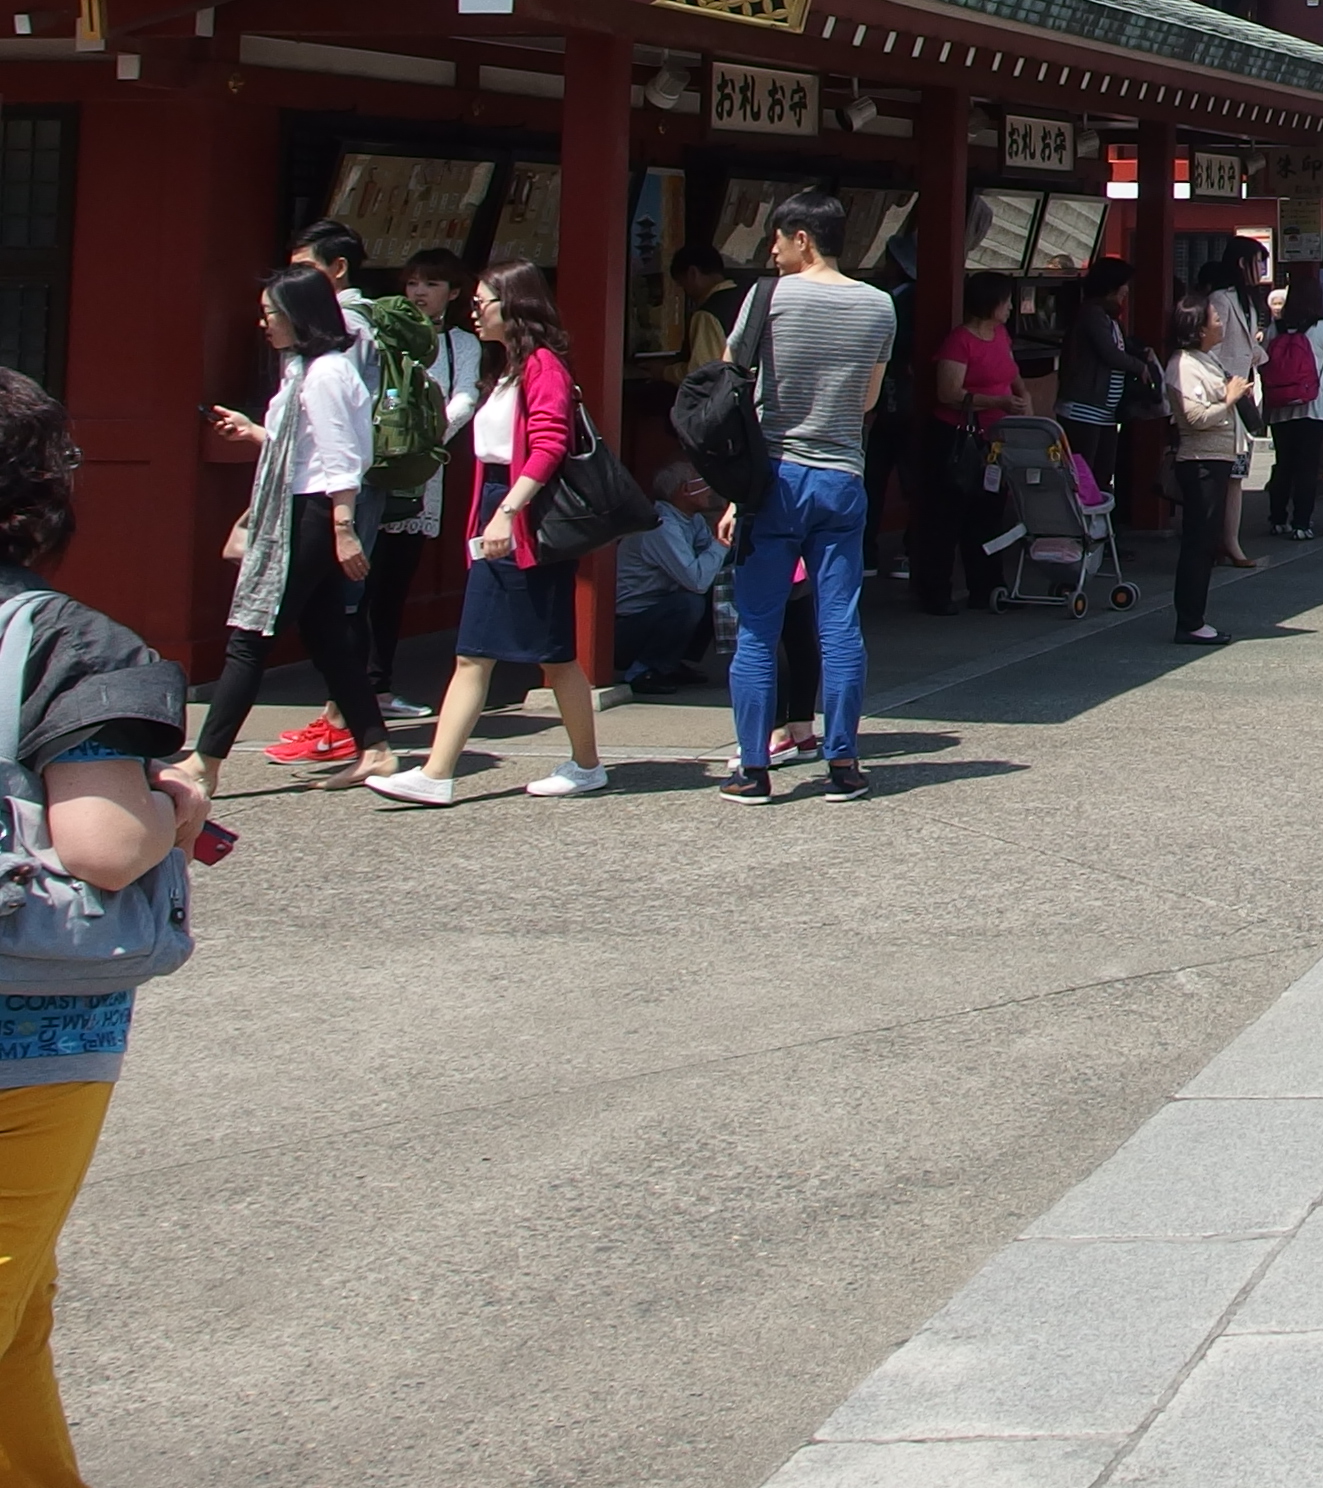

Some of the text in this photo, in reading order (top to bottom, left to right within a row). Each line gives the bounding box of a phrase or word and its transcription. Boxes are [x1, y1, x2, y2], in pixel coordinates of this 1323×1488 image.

[716, 71, 808, 128] お札お守
[1008, 122, 1066, 164] お札お守
